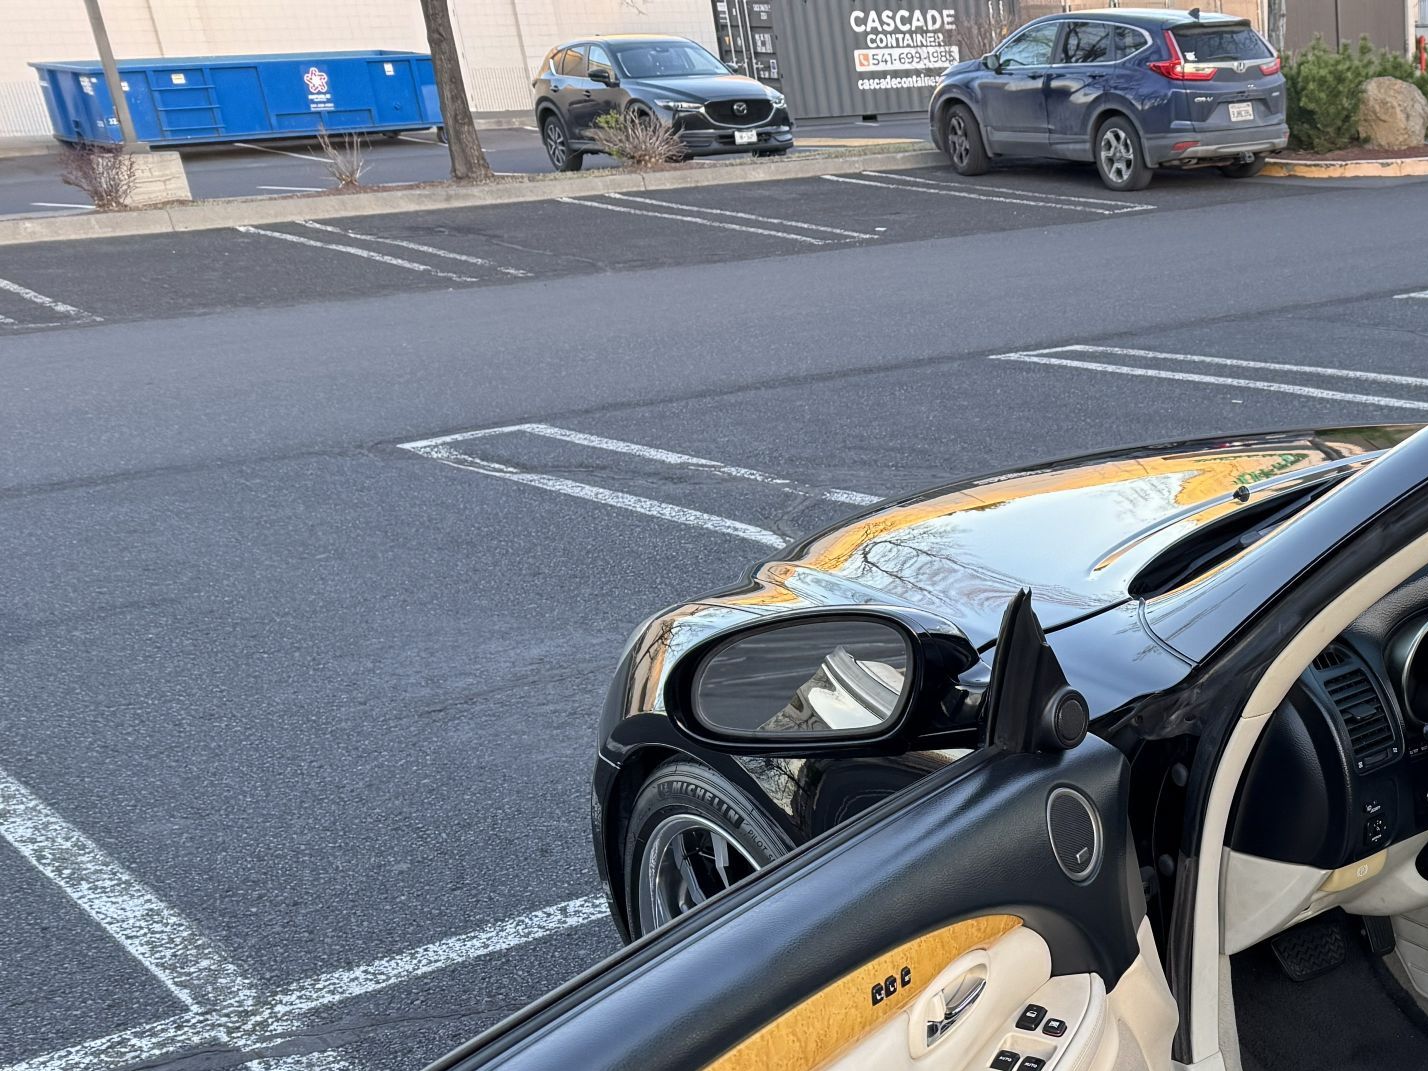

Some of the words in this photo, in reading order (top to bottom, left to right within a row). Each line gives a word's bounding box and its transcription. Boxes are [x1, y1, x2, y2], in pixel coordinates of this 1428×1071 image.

[850, 9, 956, 32] CASCADE
[867, 33, 944, 47] CONTAINER
[672, 781, 740, 824] MICHELIN
[748, 829, 768, 851] PILOT
